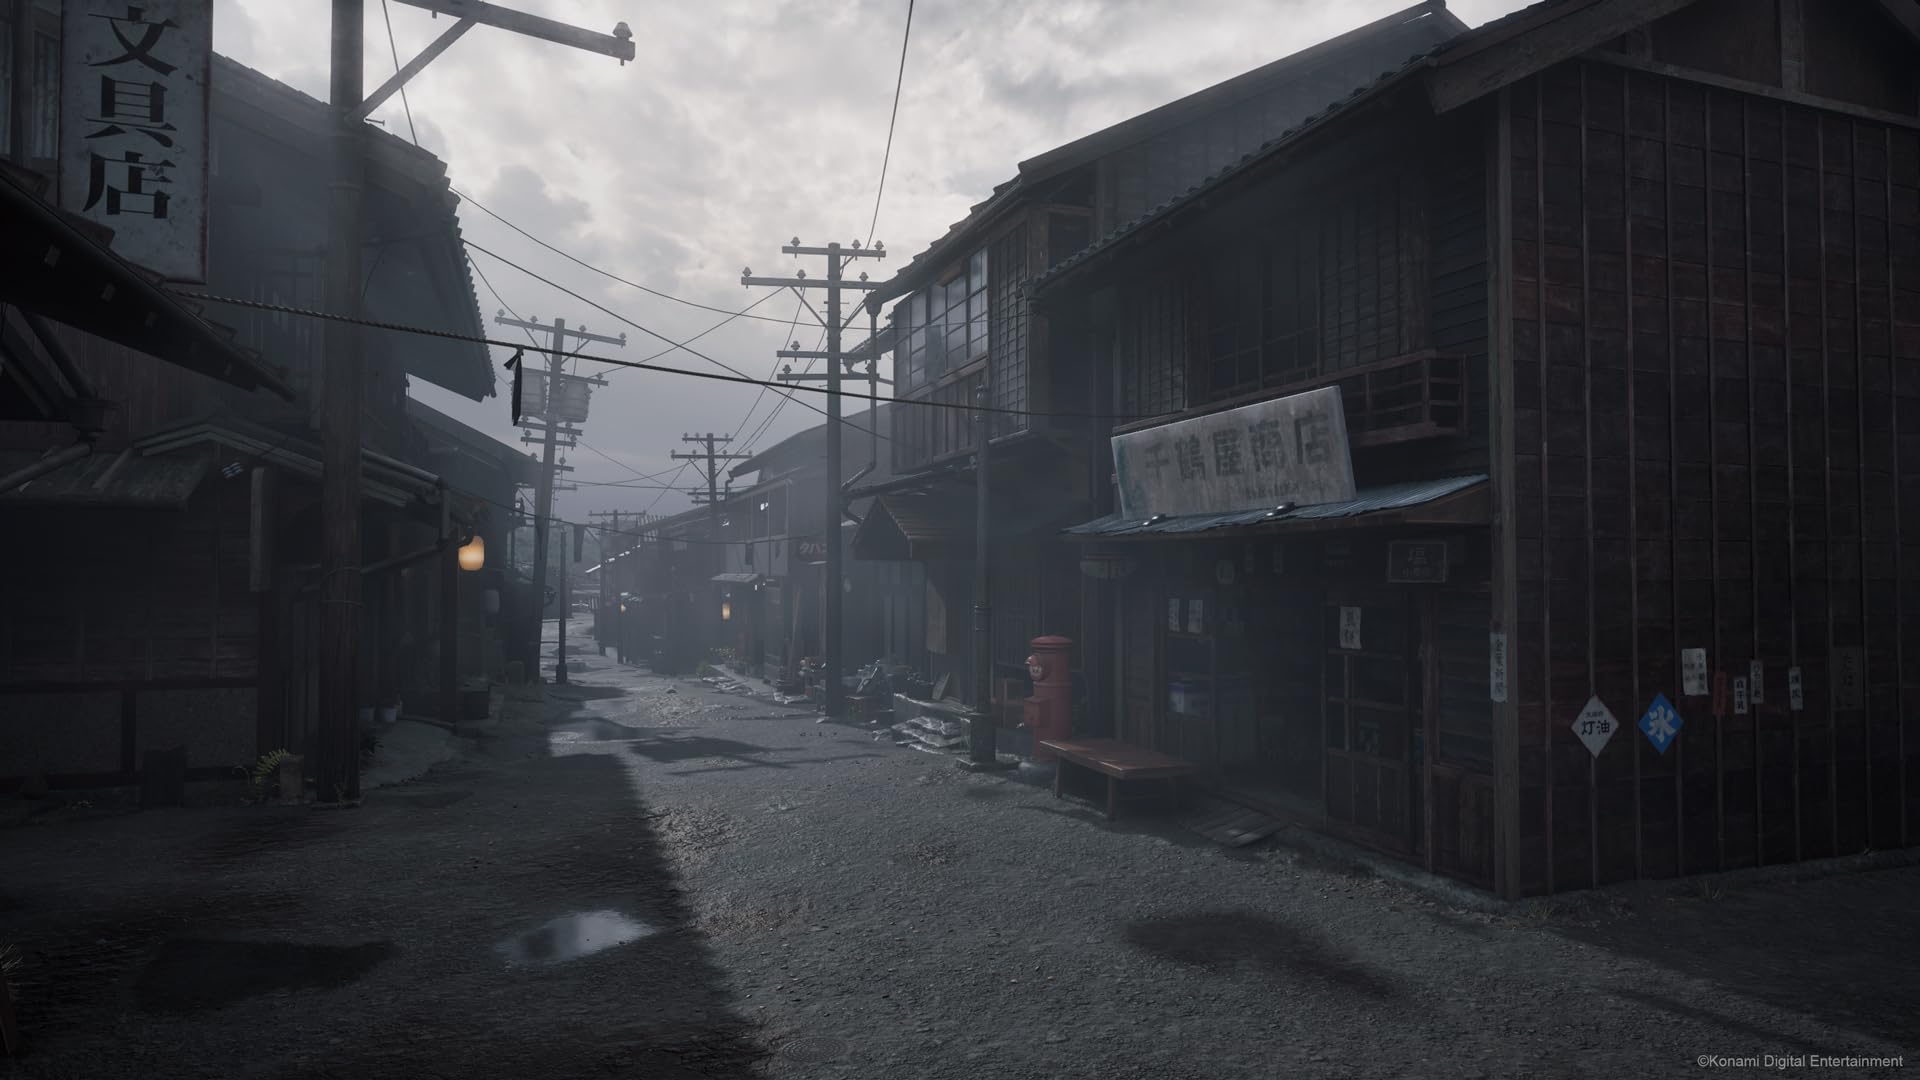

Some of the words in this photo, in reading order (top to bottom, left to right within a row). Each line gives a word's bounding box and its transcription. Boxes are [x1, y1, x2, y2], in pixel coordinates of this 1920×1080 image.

[83, 5, 180, 219] 文具店
[1582, 719, 1611, 736] 灯油
[1647, 704, 1677, 744] 氷
